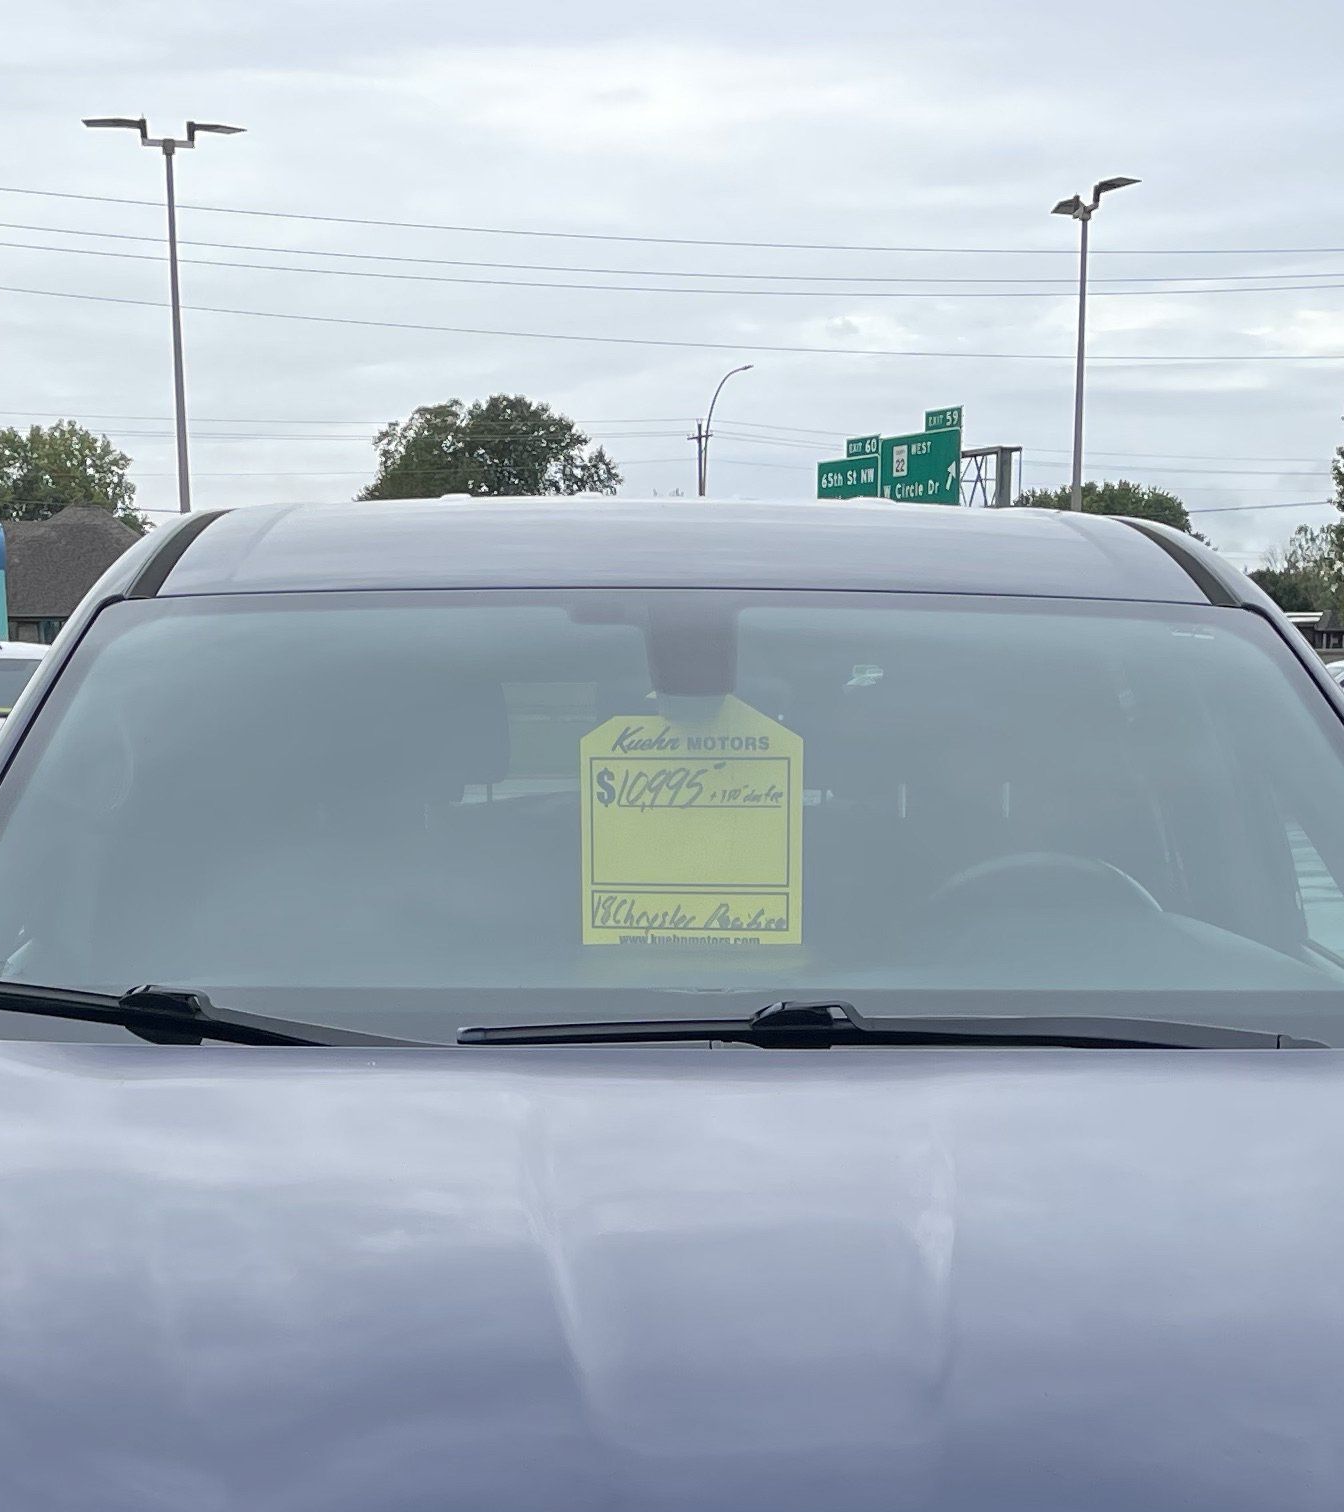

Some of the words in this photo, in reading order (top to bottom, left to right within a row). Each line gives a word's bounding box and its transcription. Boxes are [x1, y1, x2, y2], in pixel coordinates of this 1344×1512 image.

[928, 414, 944, 427] EXIT
[946, 410, 959, 426] 59
[849, 441, 863, 453] EXIT
[865, 438, 877, 453] 60
[911, 441, 932, 455] WEST
[895, 458, 905, 473] 22
[821, 470, 844, 488] 65th
[847, 469, 857, 486] St
[860, 468, 875, 483] NW
[883, 486, 892, 499] W
[895, 482, 924, 499] Circle
[927, 480, 940, 495] Dr
[612, 725, 681, 753] Kuehn
[687, 736, 770, 751] MOTORS
[619, 934, 761, 945] www.kuehnmotors.com
